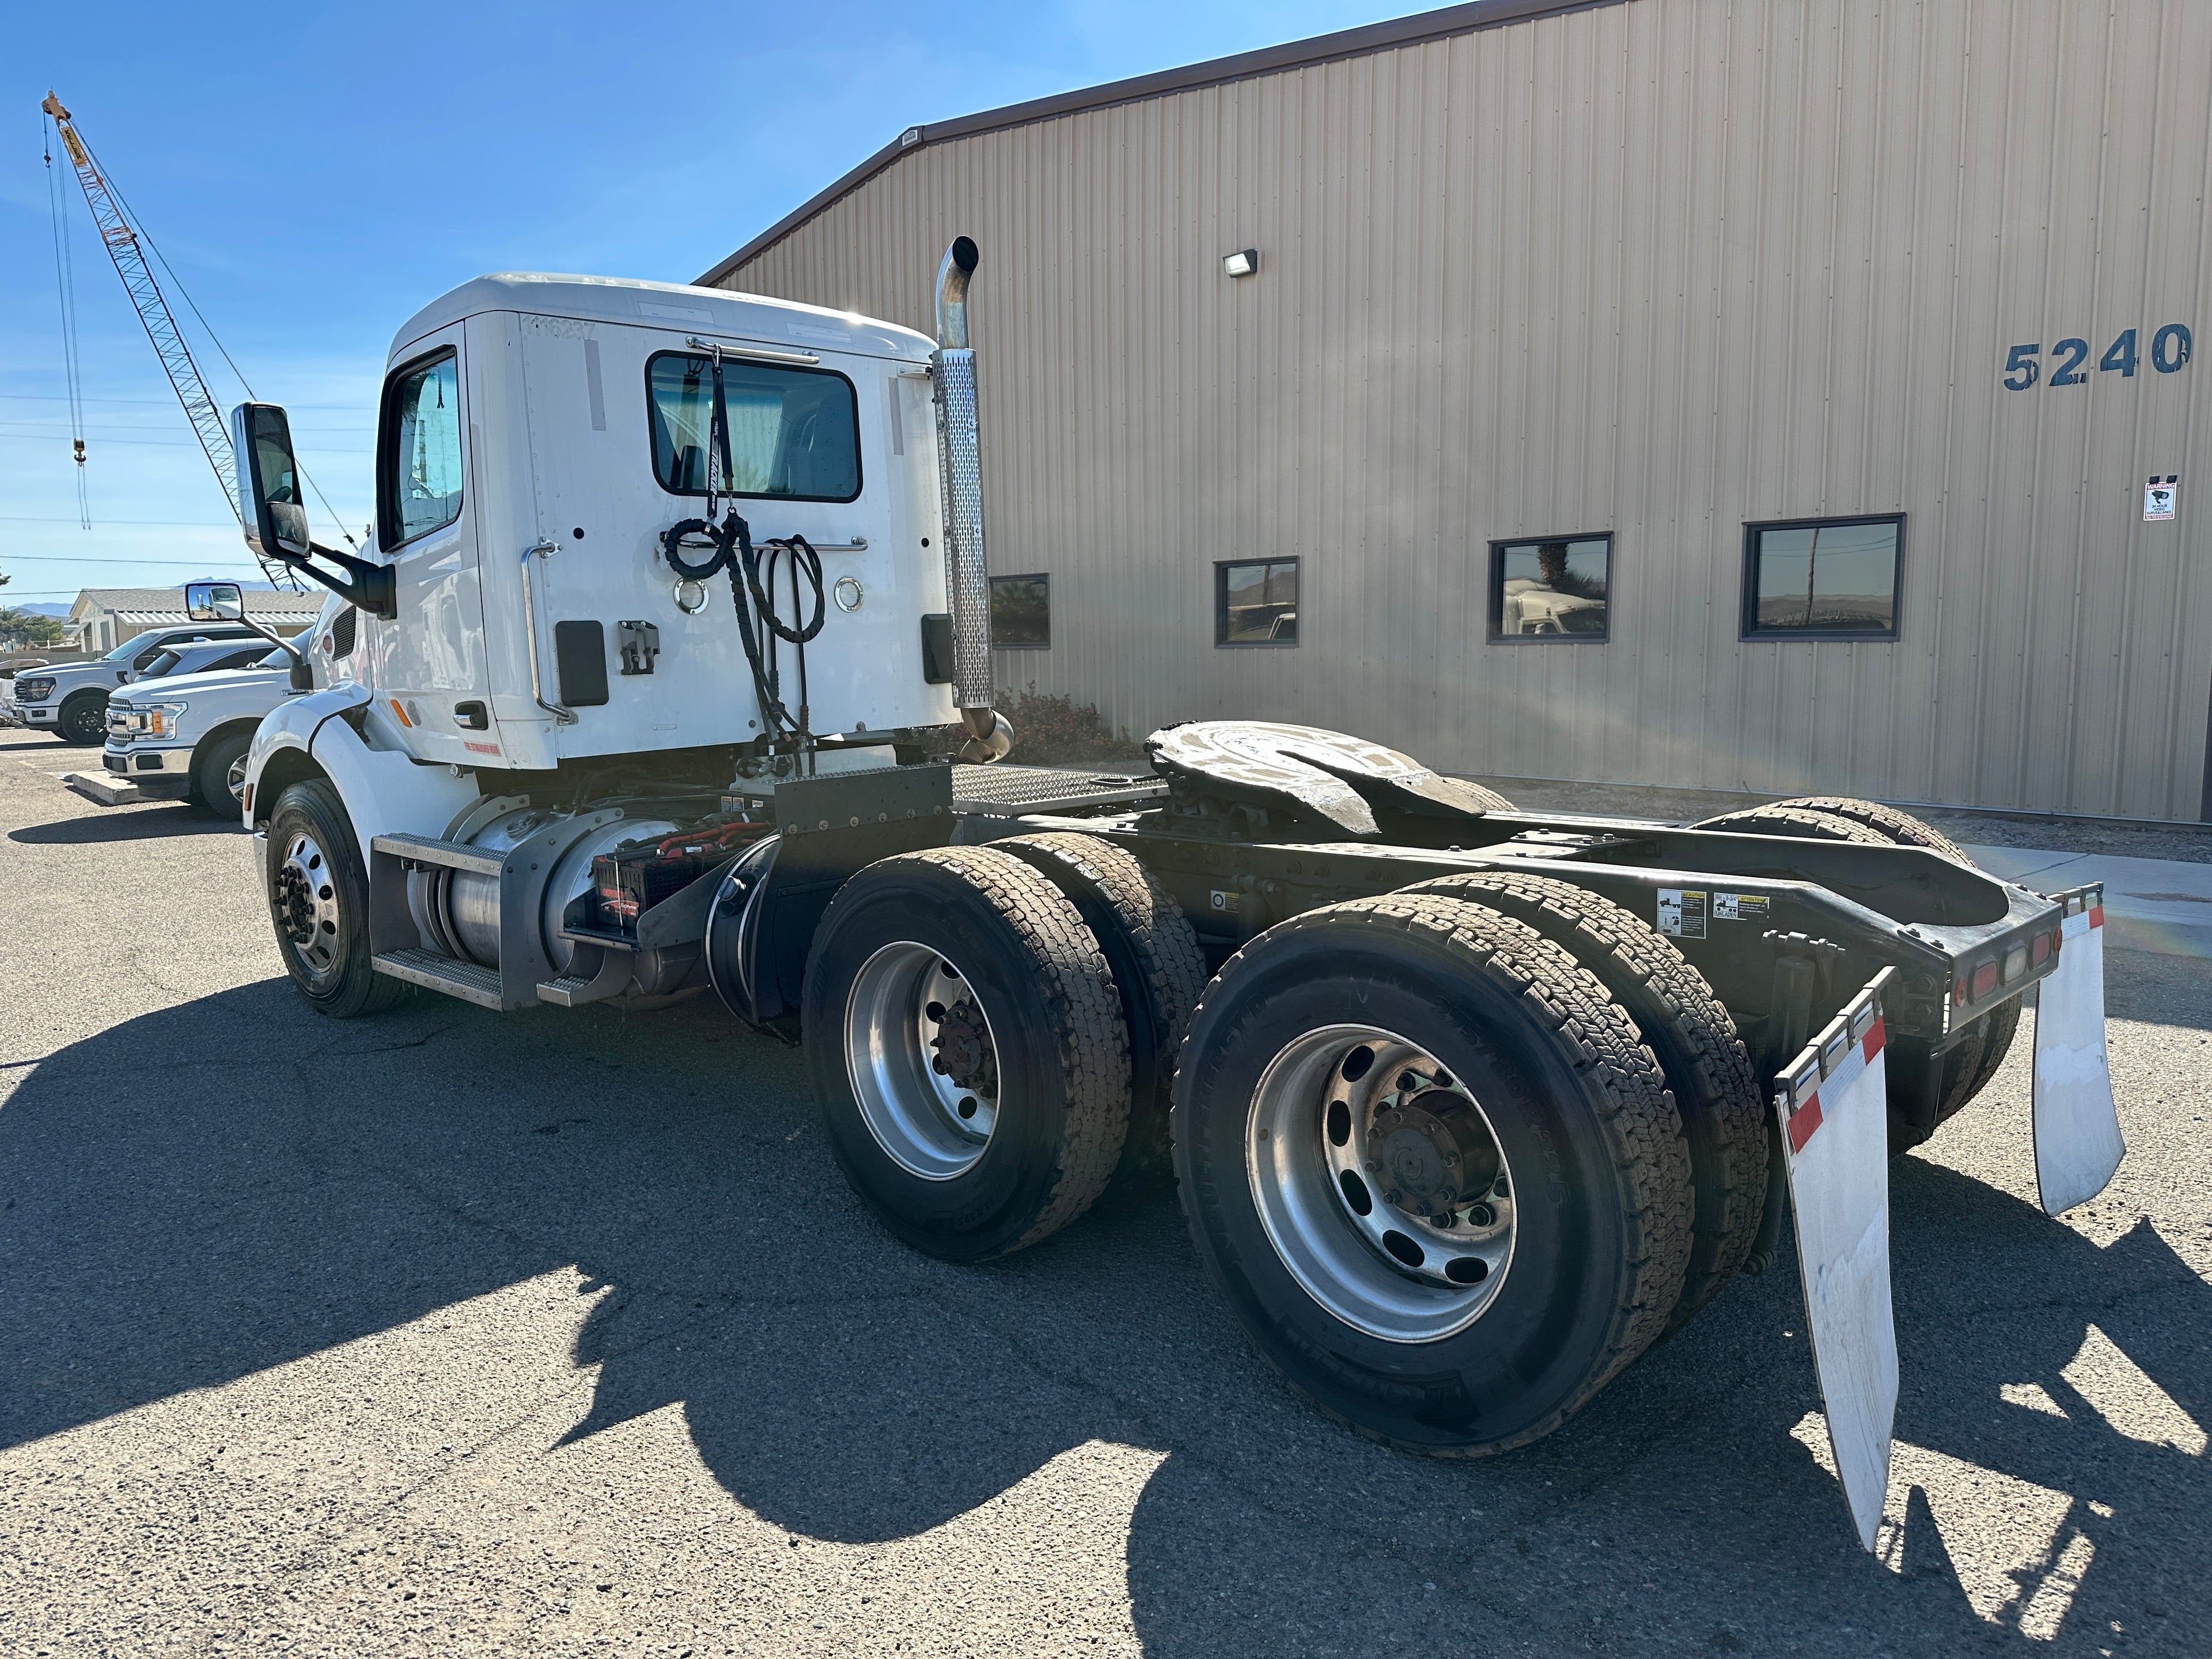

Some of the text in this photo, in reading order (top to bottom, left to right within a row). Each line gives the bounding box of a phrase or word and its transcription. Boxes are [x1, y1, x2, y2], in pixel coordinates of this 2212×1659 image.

[64, 129, 82, 160] KELLER
[2003, 323, 2192, 391] 5240
[710, 452, 719, 496] TRACKER
